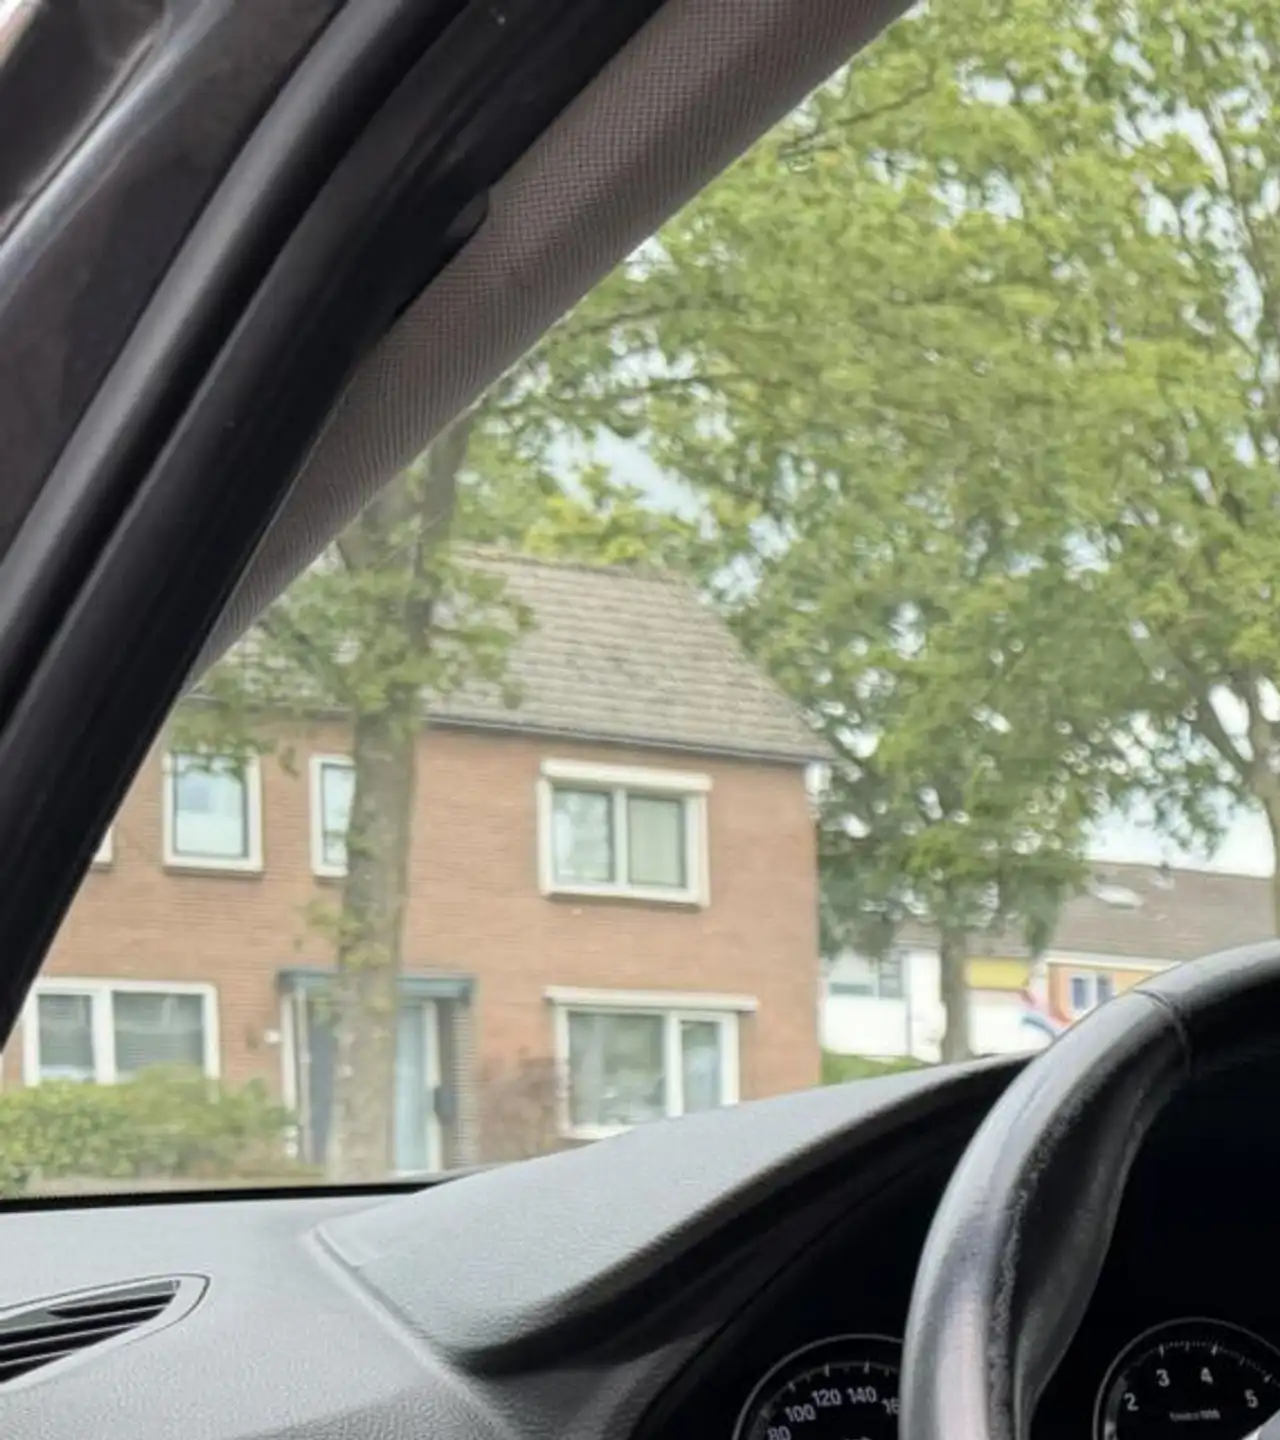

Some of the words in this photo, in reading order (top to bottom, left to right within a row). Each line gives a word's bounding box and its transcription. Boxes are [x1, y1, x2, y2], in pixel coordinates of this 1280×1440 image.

[1156, 1368, 1171, 1387] 3
[1200, 1367, 1213, 1385] 4
[811, 1388, 842, 1407] 120
[882, 1397, 901, 1416] 16
[1124, 1392, 1140, 1411] 2
[1244, 1389, 1259, 1408] 5
[784, 1403, 817, 1423] 100
